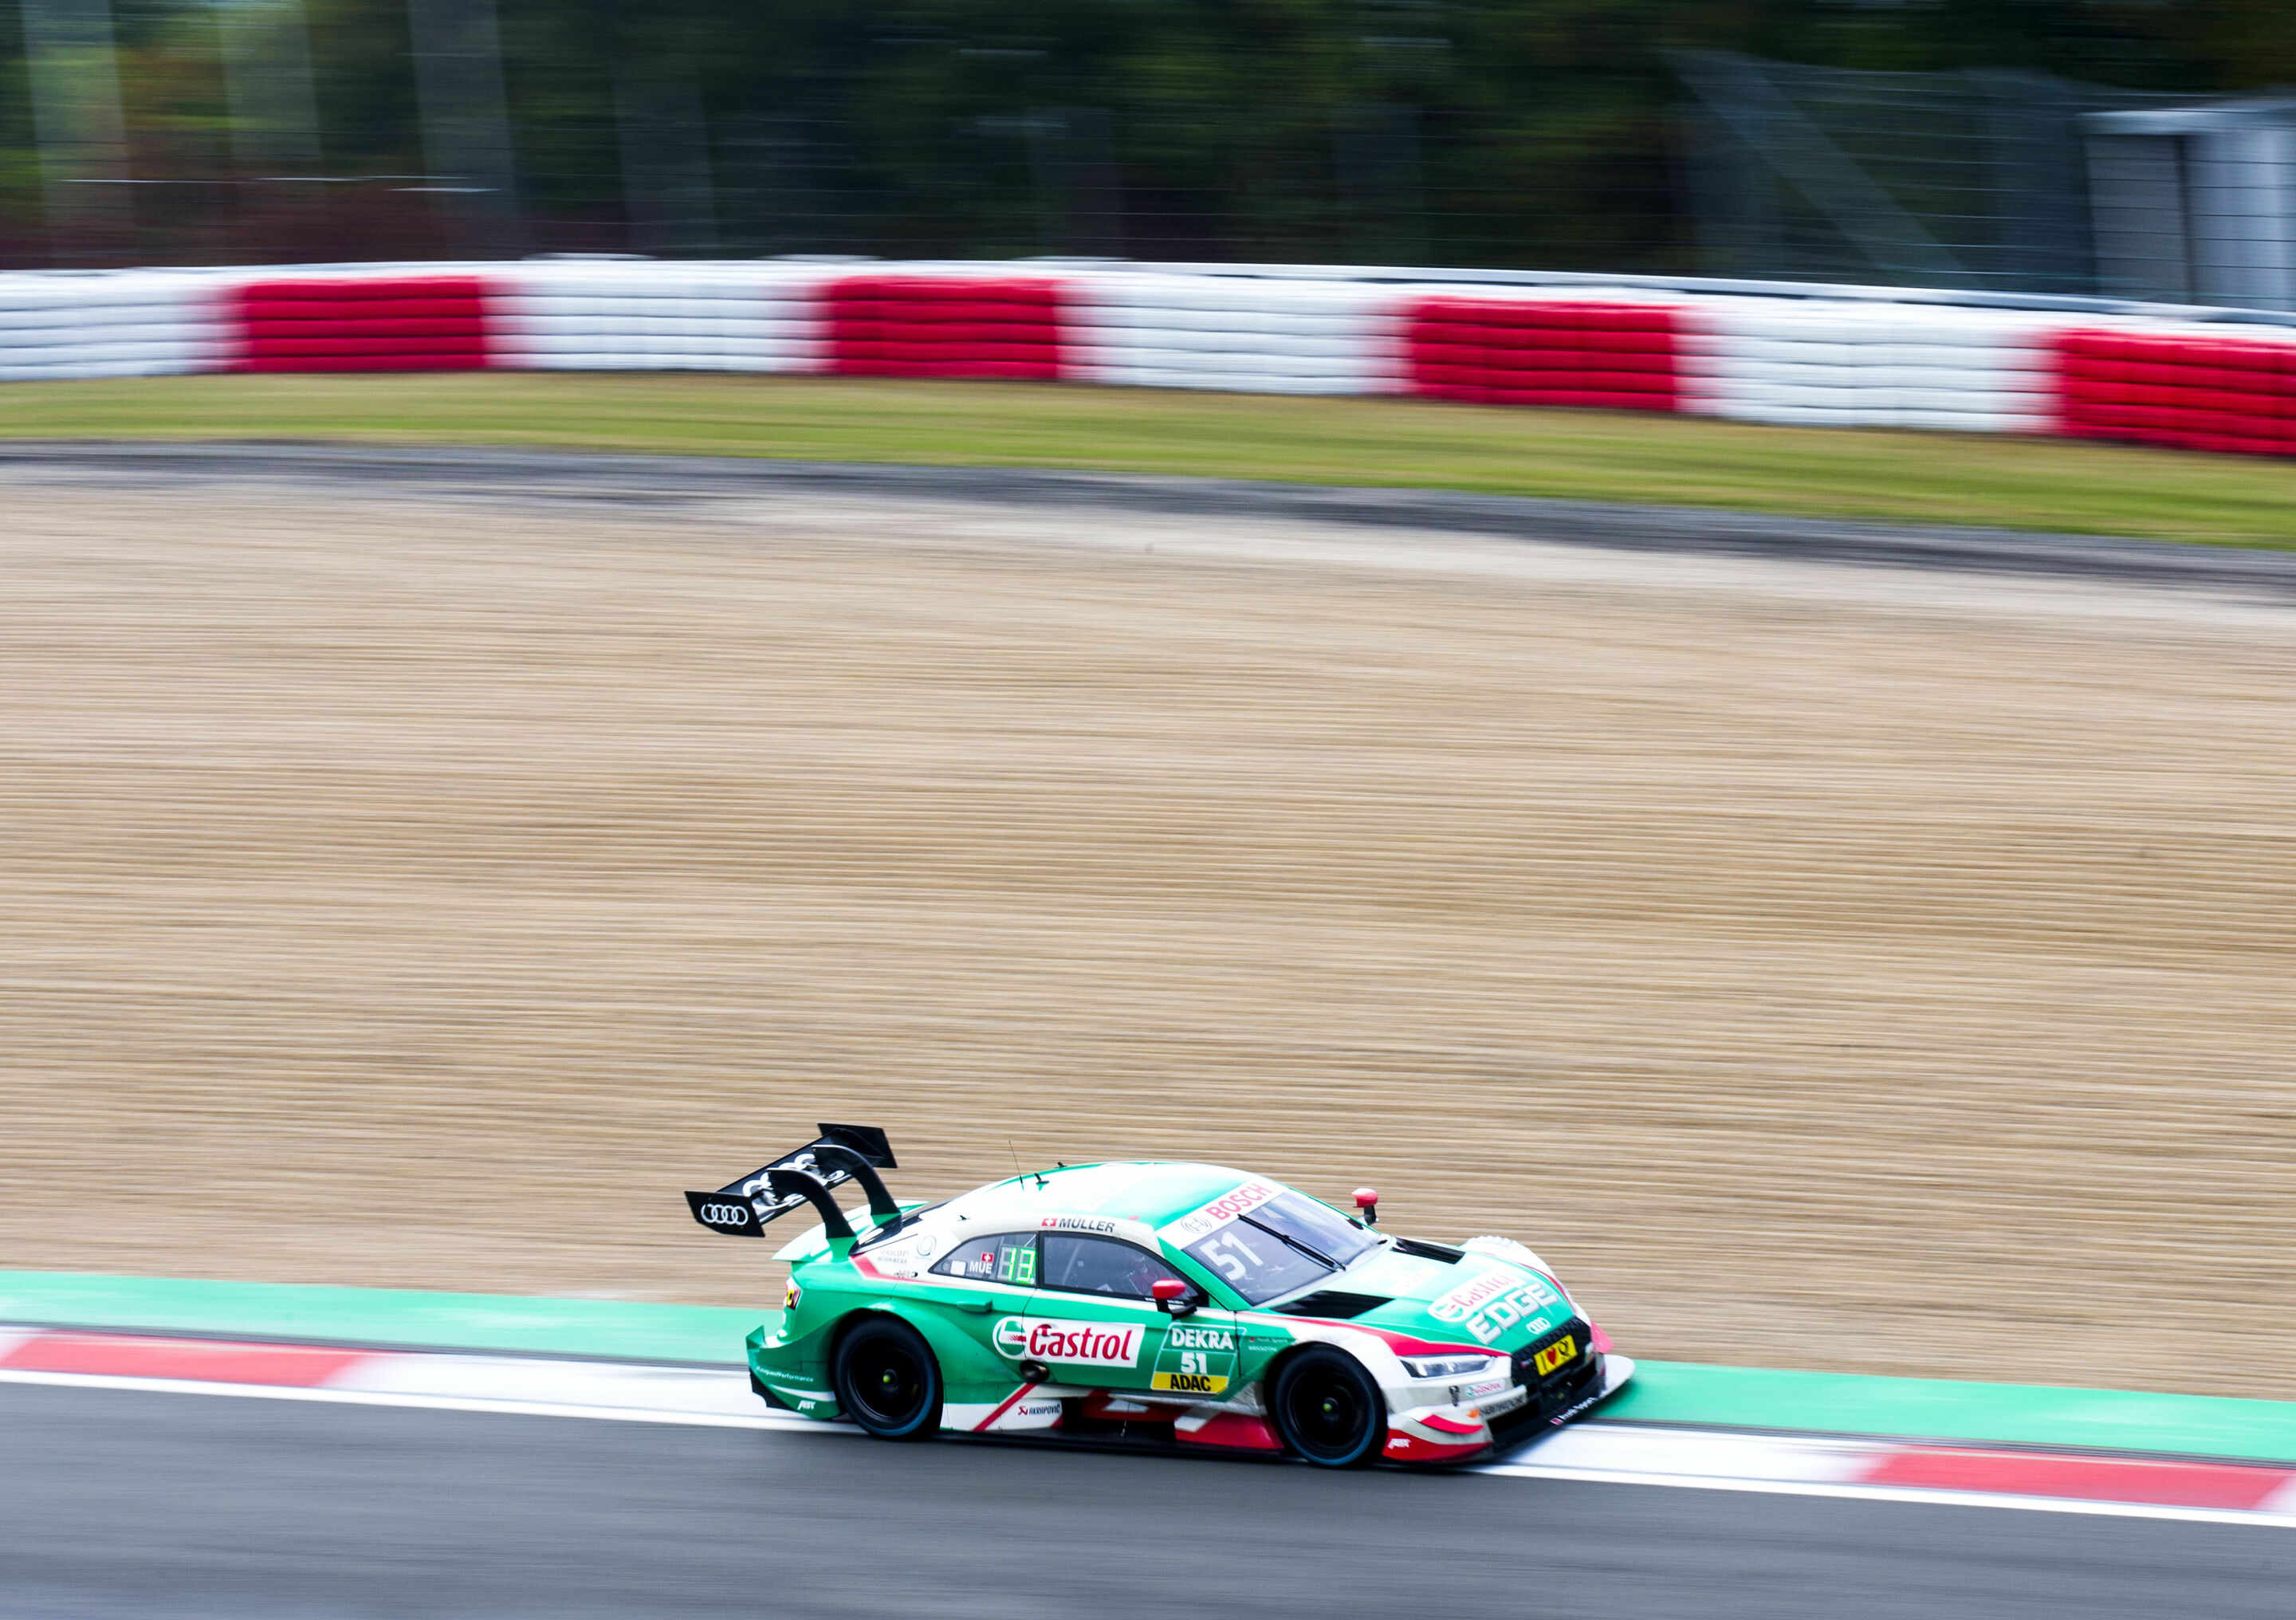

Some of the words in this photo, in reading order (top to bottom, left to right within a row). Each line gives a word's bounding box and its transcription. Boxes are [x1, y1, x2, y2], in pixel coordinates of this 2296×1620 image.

[1205, 1183, 1273, 1221] BOSCH
[969, 1260, 993, 1274] MUE
[1008, 1247, 1036, 1284] 13
[1198, 1231, 1264, 1281] 51
[1465, 1283, 1559, 1346] EDGE
[1029, 1323, 1132, 1360] Castrol
[1171, 1327, 1234, 1350] DEKRA
[1181, 1351, 1208, 1374] 51
[1170, 1374, 1211, 1392] ADAC
